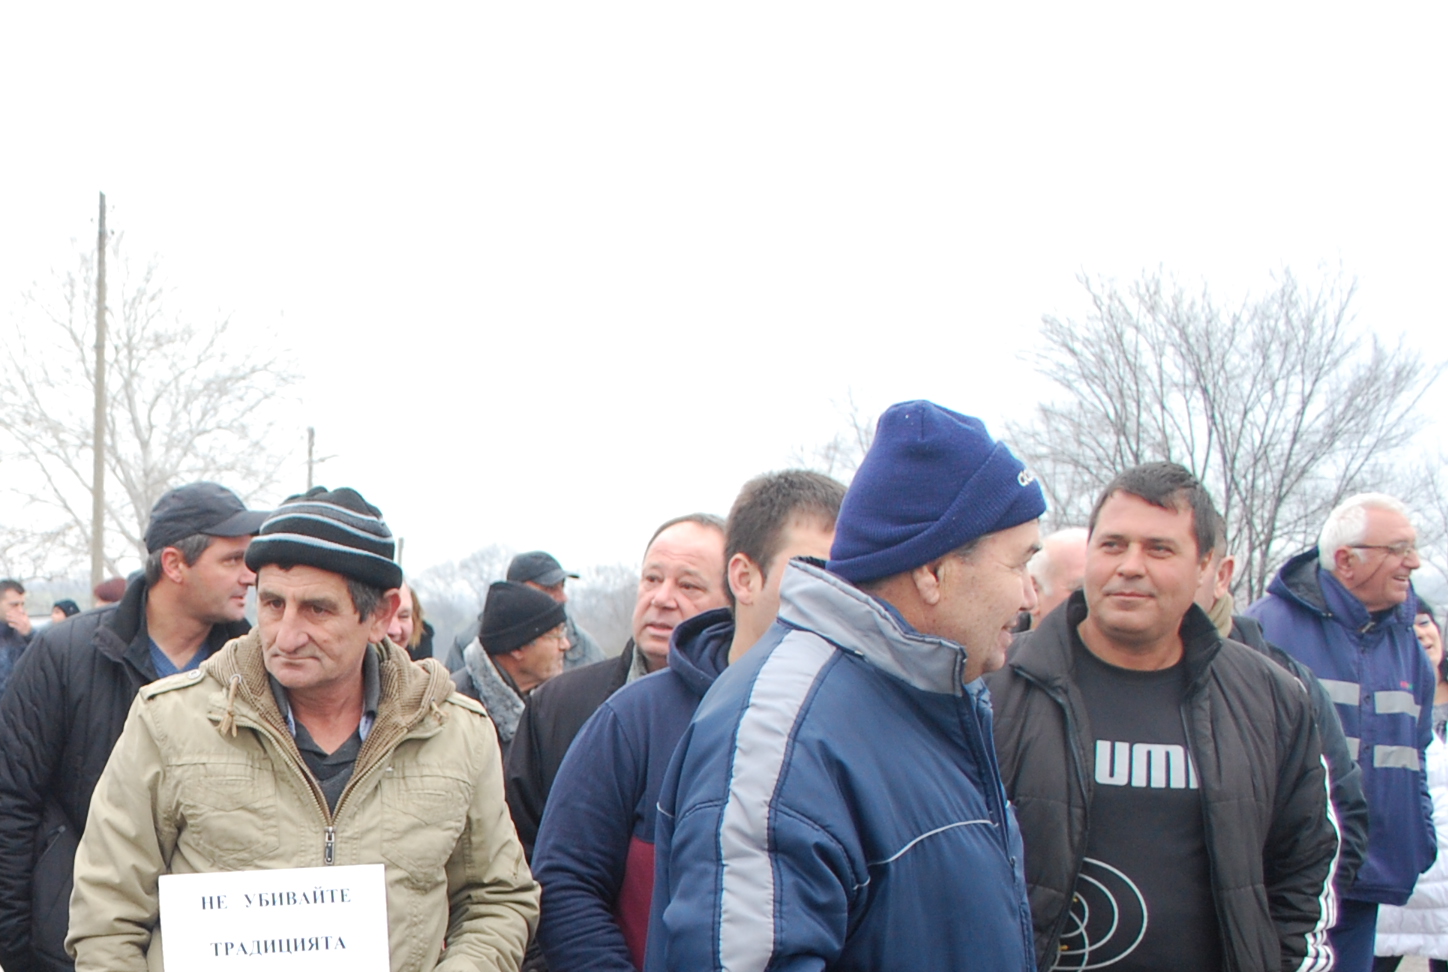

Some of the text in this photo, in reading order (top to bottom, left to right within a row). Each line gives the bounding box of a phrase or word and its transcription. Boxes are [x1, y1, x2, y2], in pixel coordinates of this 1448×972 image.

[201, 886, 351, 911] НЕ УБИВАЙТЕ
[209, 935, 346, 957] ТРАДИЦИЯТА
